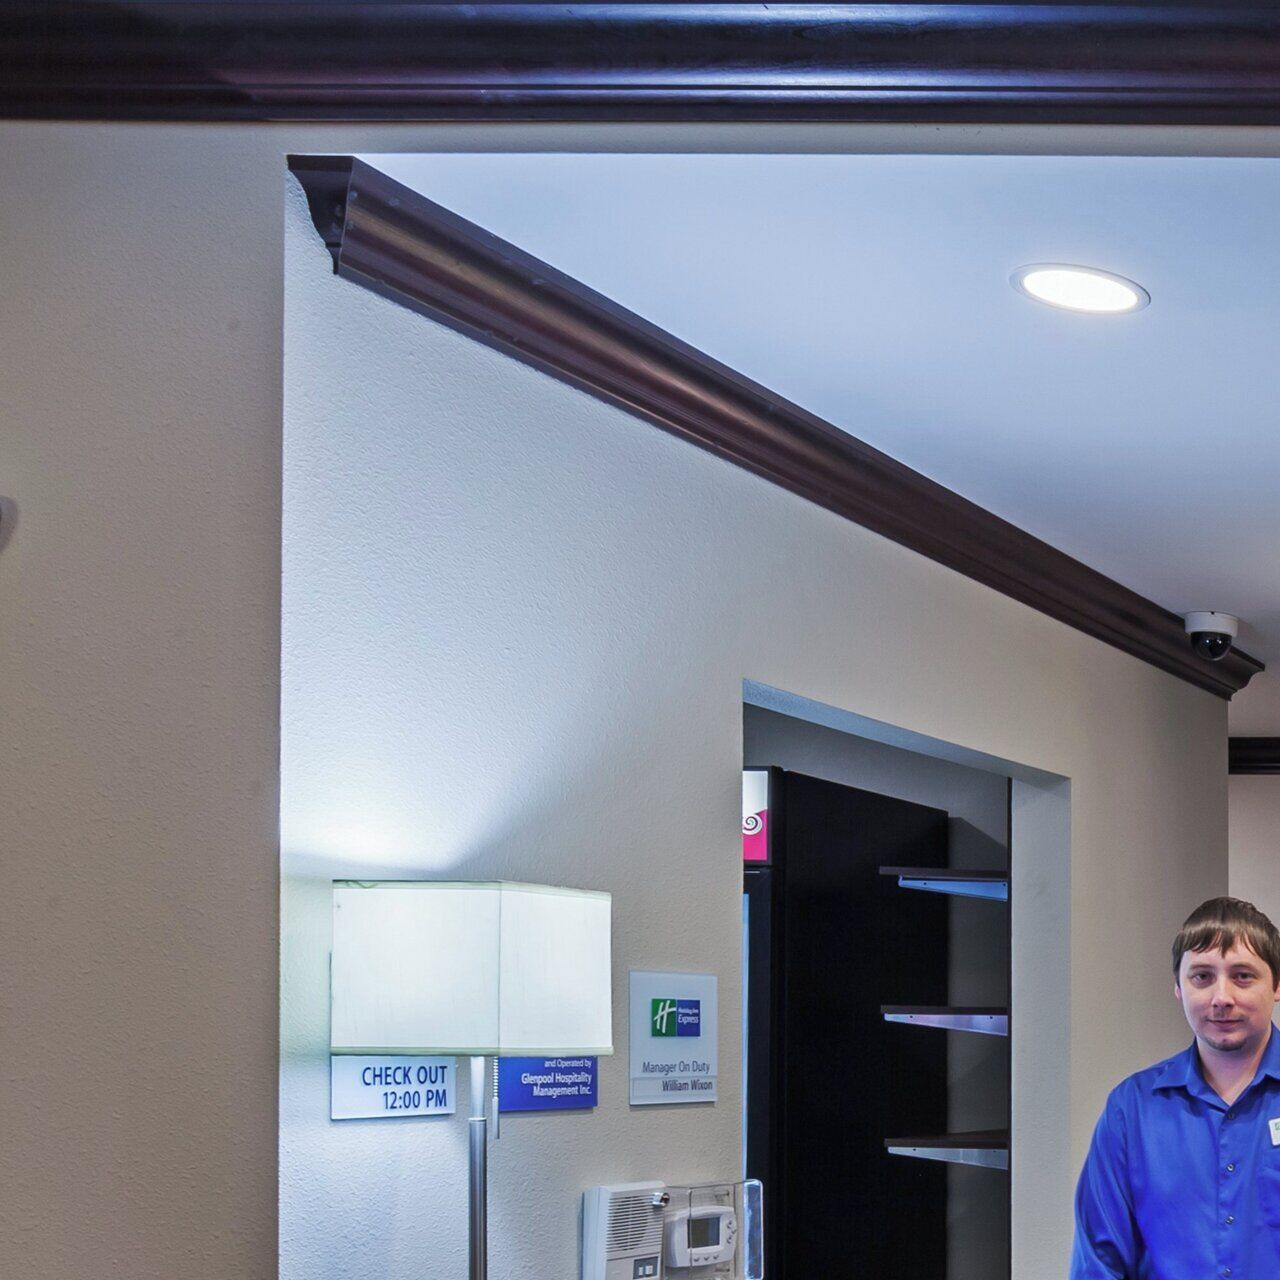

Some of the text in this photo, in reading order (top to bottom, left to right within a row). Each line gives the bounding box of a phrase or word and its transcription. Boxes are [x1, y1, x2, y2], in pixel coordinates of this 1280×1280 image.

[544, 1059, 592, 1069] and Operated by
[643, 1060, 710, 1075] Manager On Duty
[362, 1065, 447, 1086] CHECK OUT
[521, 1072, 592, 1086] Glenpool Hospitality
[533, 1085, 592, 1098] Management Inc.
[662, 1080, 713, 1091] William Wixon
[383, 1089, 447, 1109] 12:00 PM
